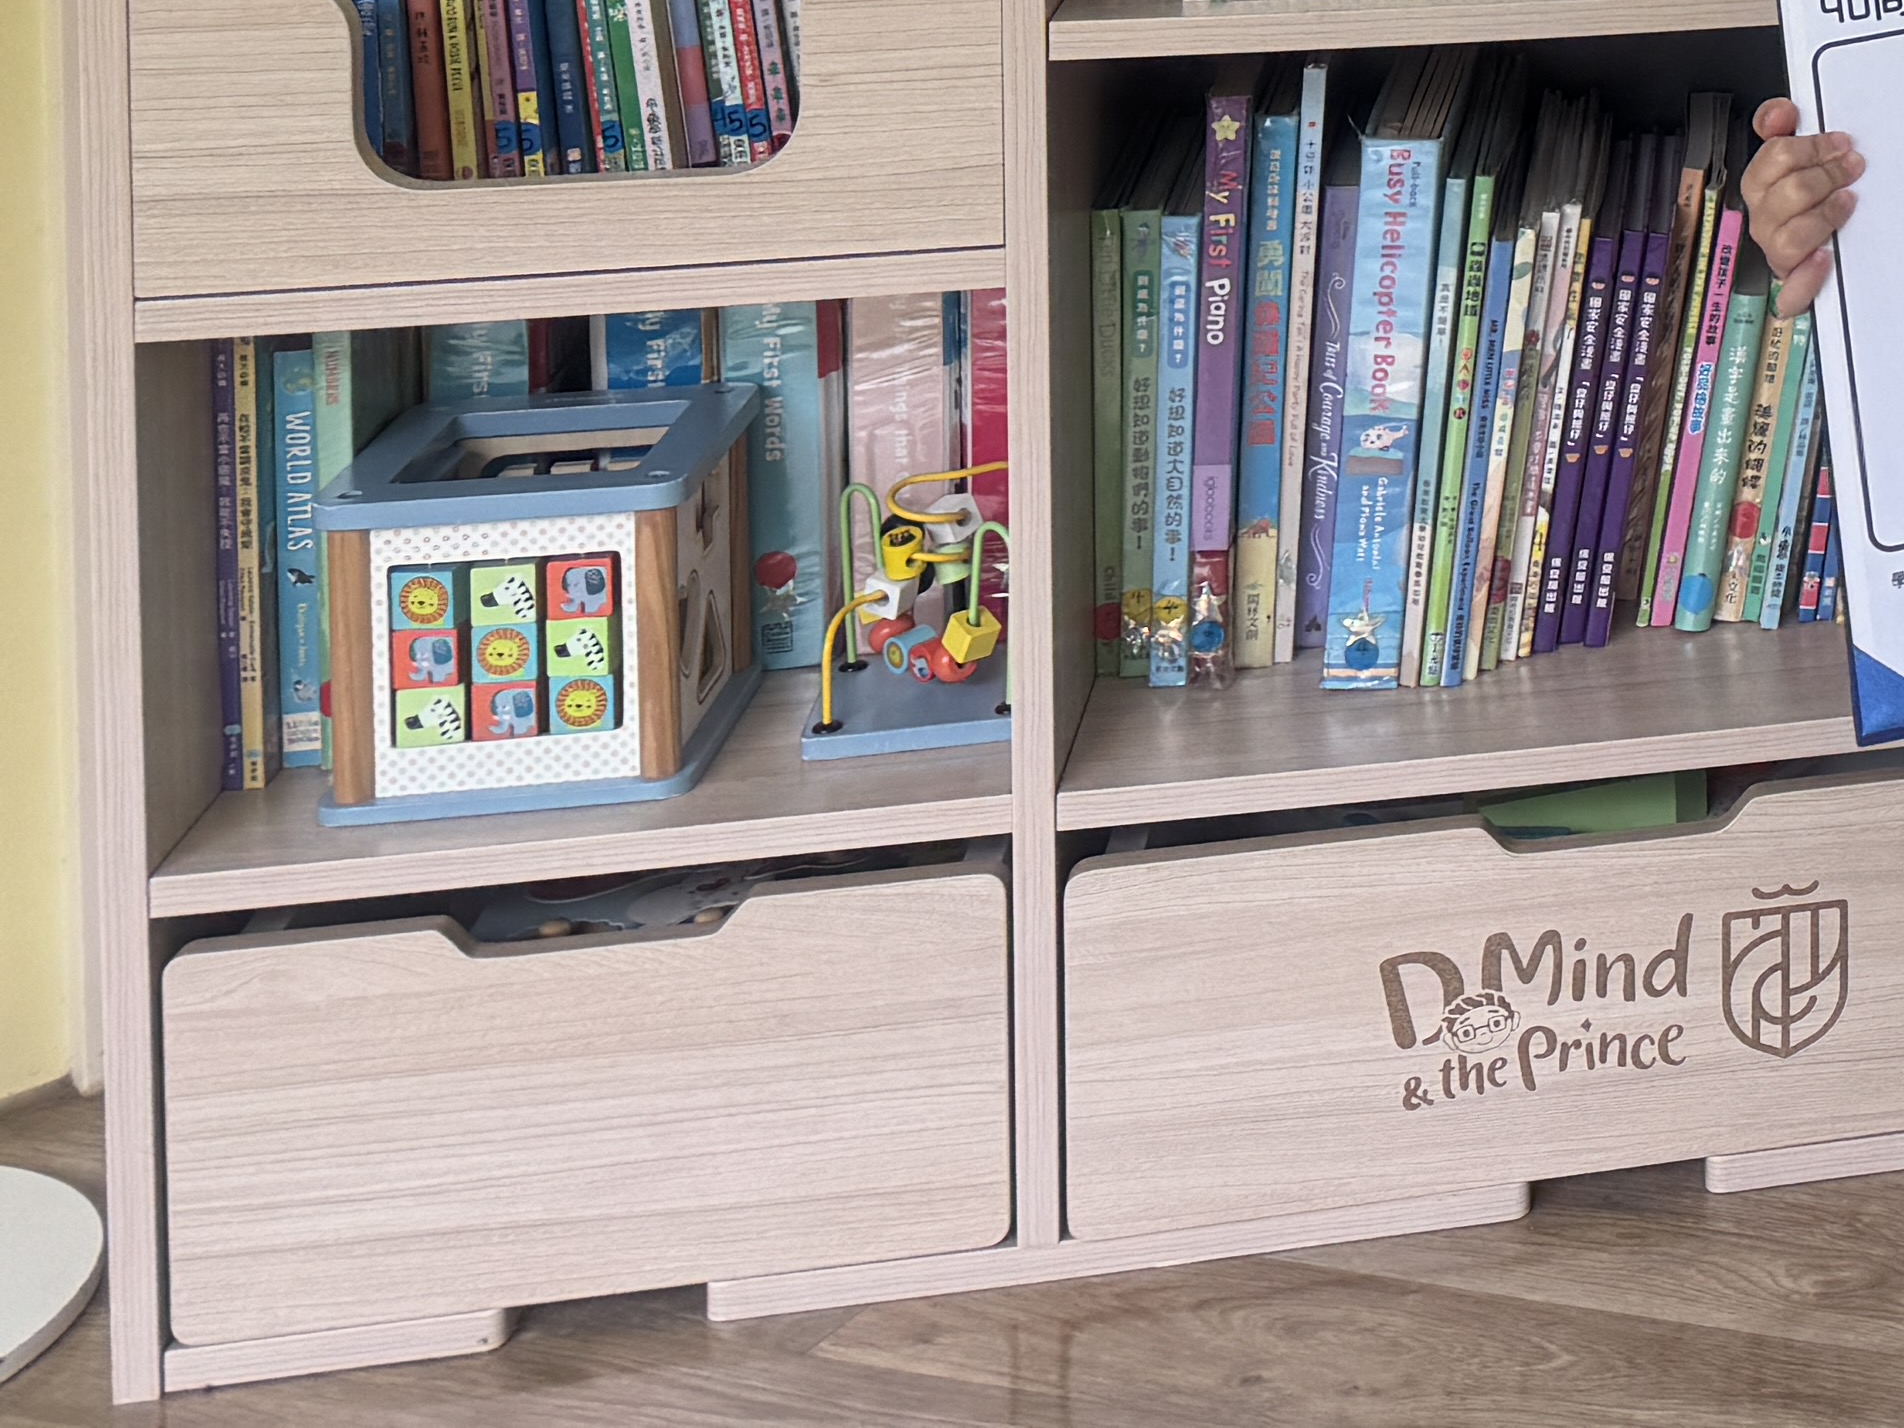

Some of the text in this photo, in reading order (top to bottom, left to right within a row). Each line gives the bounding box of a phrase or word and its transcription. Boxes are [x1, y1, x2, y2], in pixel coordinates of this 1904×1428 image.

[1203, 169, 1244, 346] My First Piano
[1368, 148, 1412, 415] Busy Helicopter Book
[284, 410, 314, 552] WORLD ATLAS
[764, 395, 786, 462] Words
[1481, 912, 1695, 1007] Mind
[1402, 1018, 1688, 1112] & the Prince
